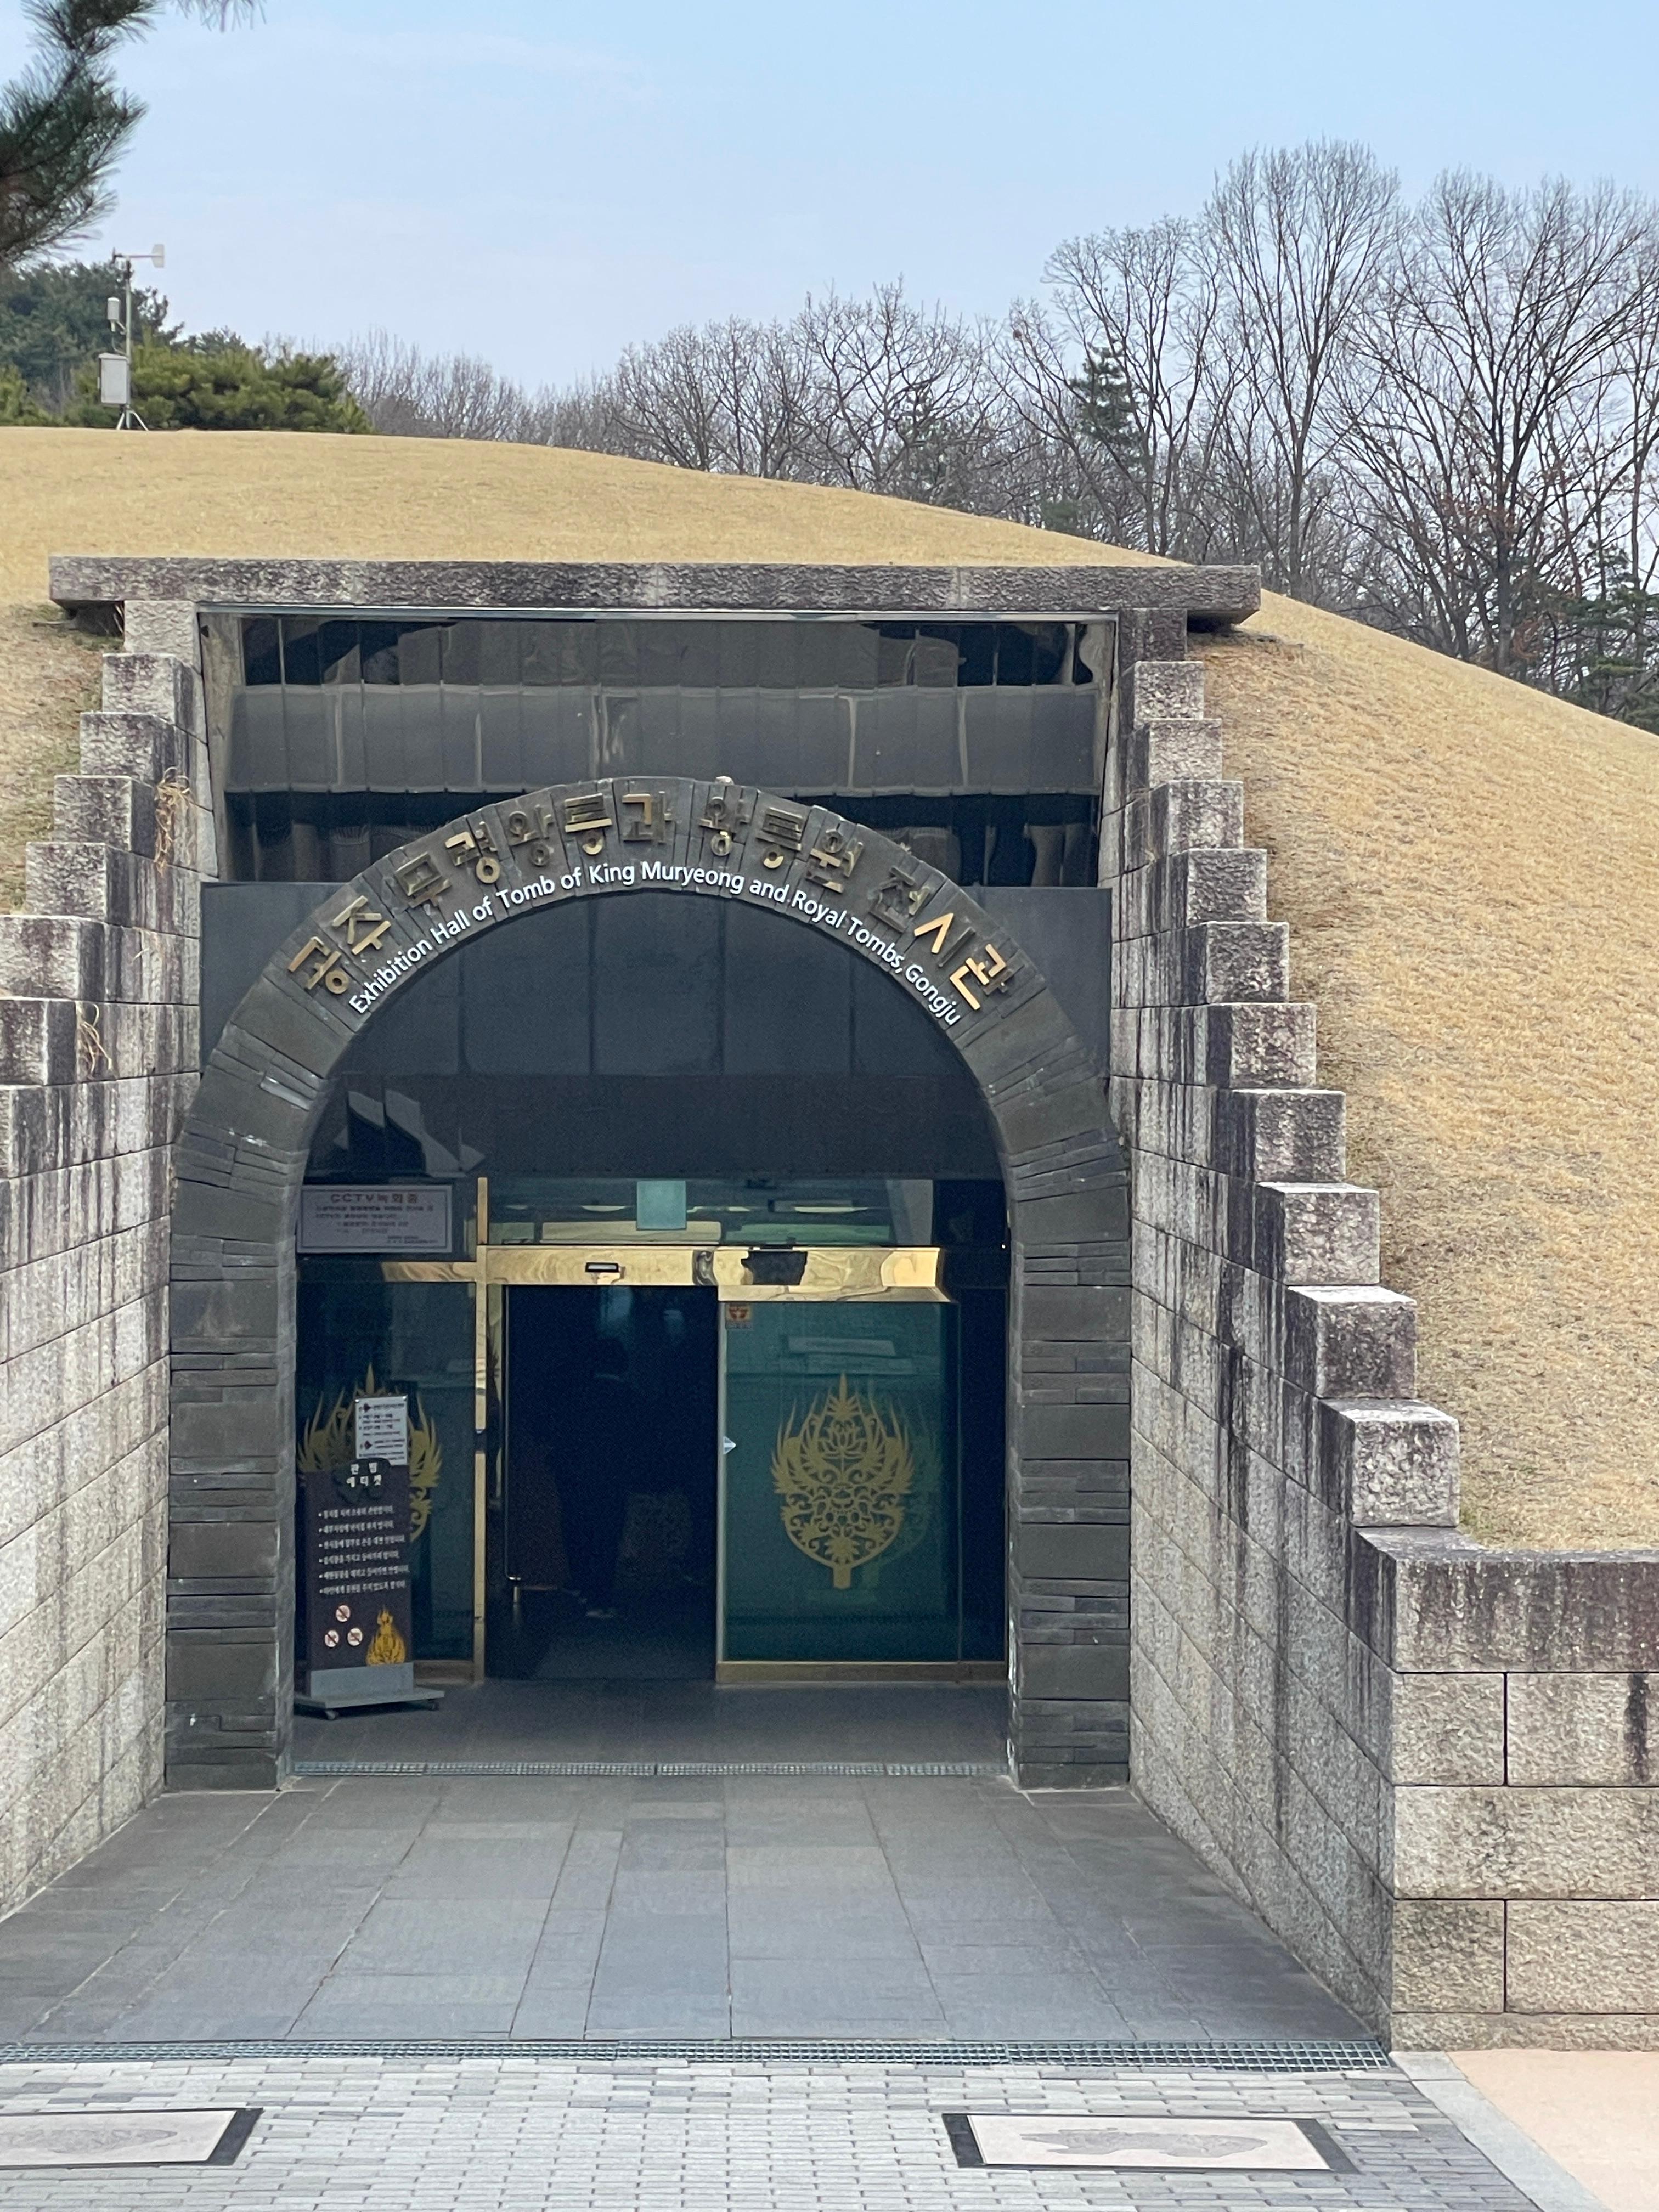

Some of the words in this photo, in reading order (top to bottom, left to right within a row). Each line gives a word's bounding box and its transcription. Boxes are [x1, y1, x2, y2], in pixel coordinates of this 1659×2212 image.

[287, 894, 391, 995] 공주
[394, 790, 674, 909] 무령왕릉과
[698, 795, 864, 893] 왕릉원
[869, 865, 1025, 1011] 전시관
[348, 939, 433, 1014] Exhibition
[429, 909, 471, 944] Hall
[472, 895, 493, 921] of
[495, 874, 556, 909] Tomb
[561, 866, 582, 890] of
[588, 862, 635, 886] King
[641, 860, 746, 895] Muryeong
[749, 879, 791, 903] and
[791, 889, 848, 928] Royal
[848, 916, 905, 974] Tombs,
[905, 963, 961, 1026] Gongju
